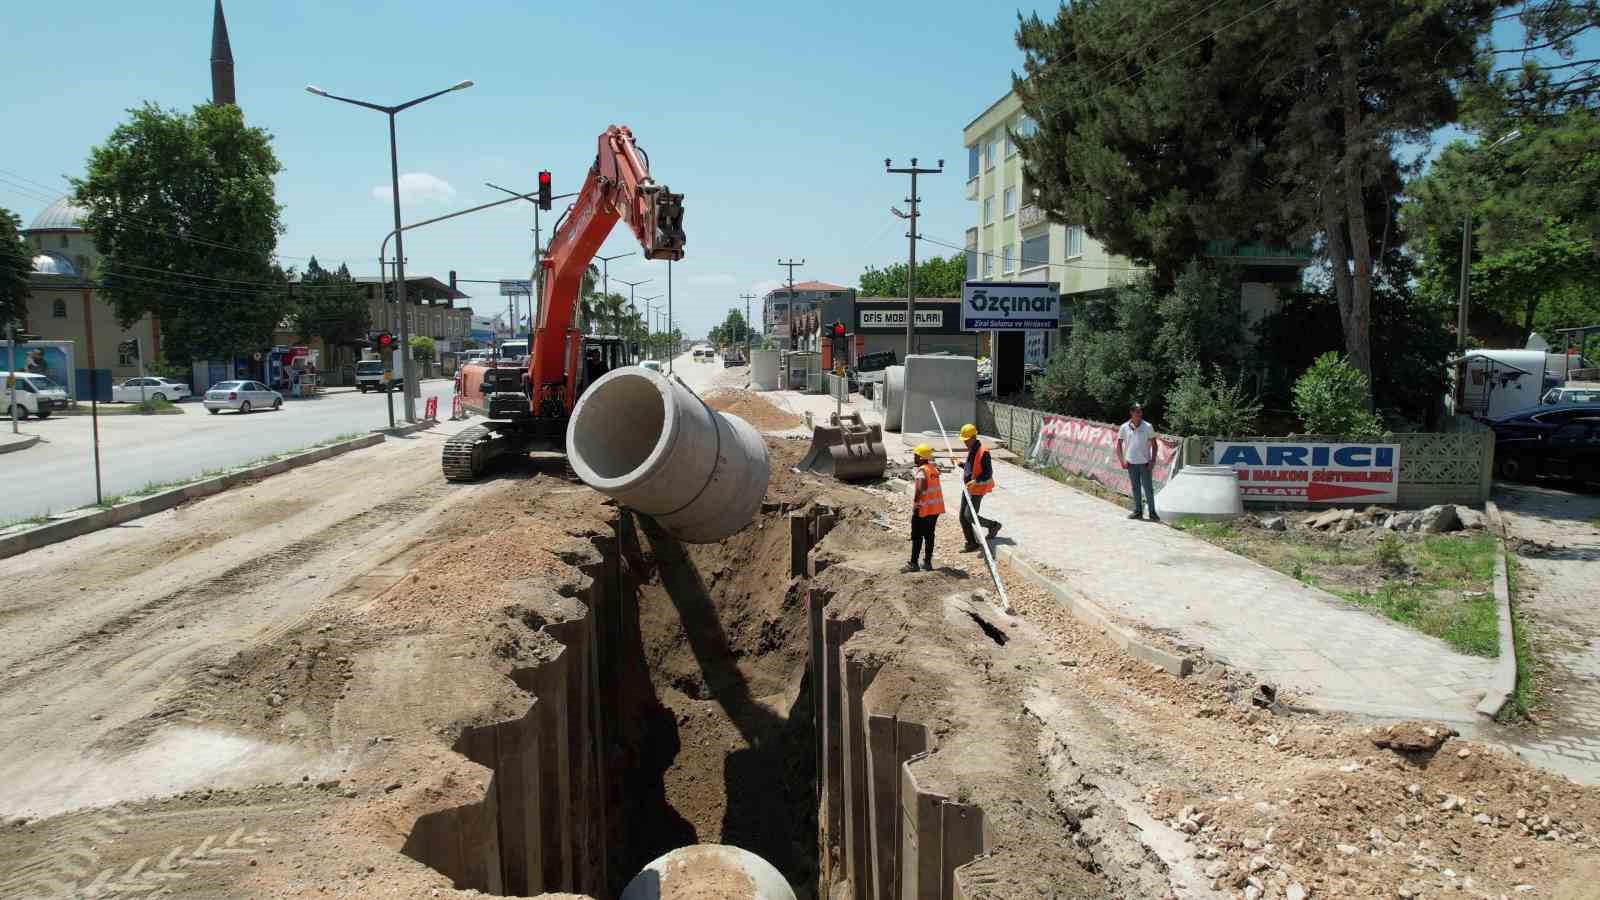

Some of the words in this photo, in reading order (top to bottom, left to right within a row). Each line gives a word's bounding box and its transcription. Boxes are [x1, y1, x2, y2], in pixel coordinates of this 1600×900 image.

[863, 311, 882, 323] OFİS
[885, 311, 940, 323] MOBİALARI
[1219, 445, 1393, 467] ARICI
[1253, 469, 1309, 481] BALKON
